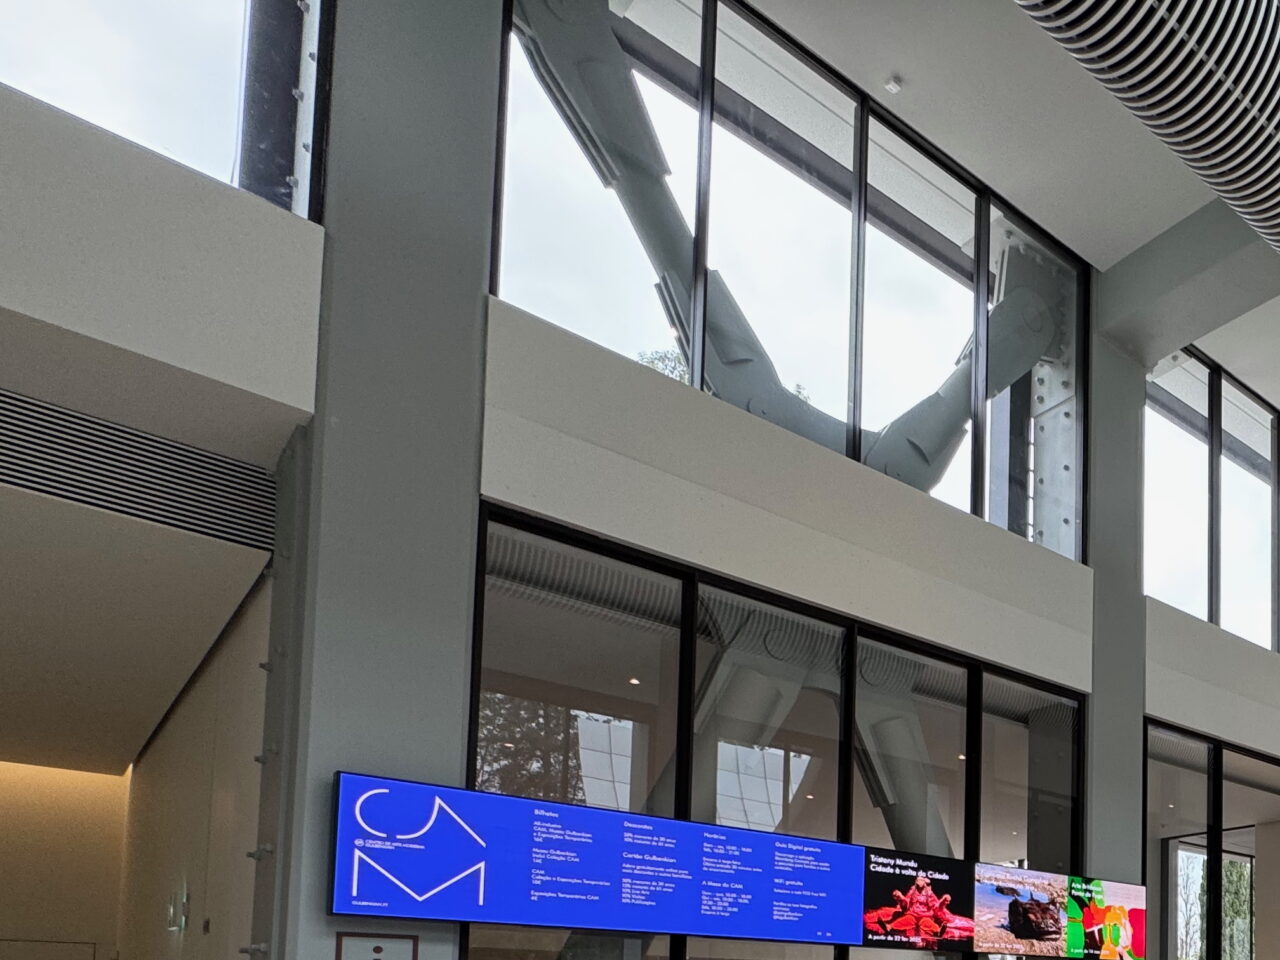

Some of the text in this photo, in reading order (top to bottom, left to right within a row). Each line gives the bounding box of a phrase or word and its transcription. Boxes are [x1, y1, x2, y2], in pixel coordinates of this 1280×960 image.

[534, 809, 559, 818] Bilhetes
[624, 821, 653, 830] Descontos
[704, 832, 726, 840] Horários
[644, 854, 677, 863] Gulbenkian
[870, 854, 918, 868] Tristany Mundu
[870, 864, 894, 874] Cidade
[901, 868, 917, 877] volta
[927, 871, 950, 880] Cidade
